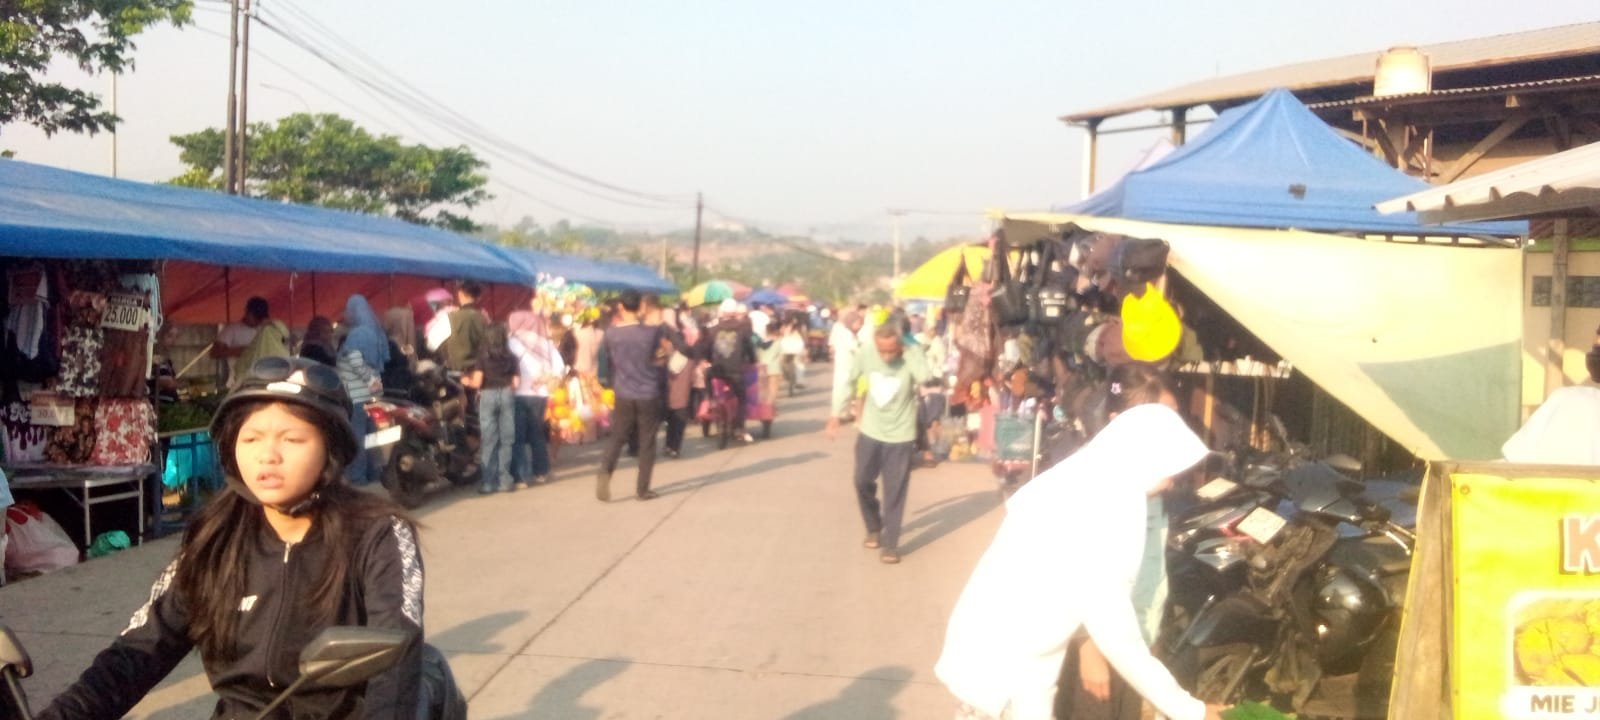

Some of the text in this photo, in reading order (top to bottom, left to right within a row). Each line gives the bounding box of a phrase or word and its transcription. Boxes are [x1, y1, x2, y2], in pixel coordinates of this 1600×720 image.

[104, 305, 139, 325] 25.000
[1531, 694, 1600, 714] MIE J
